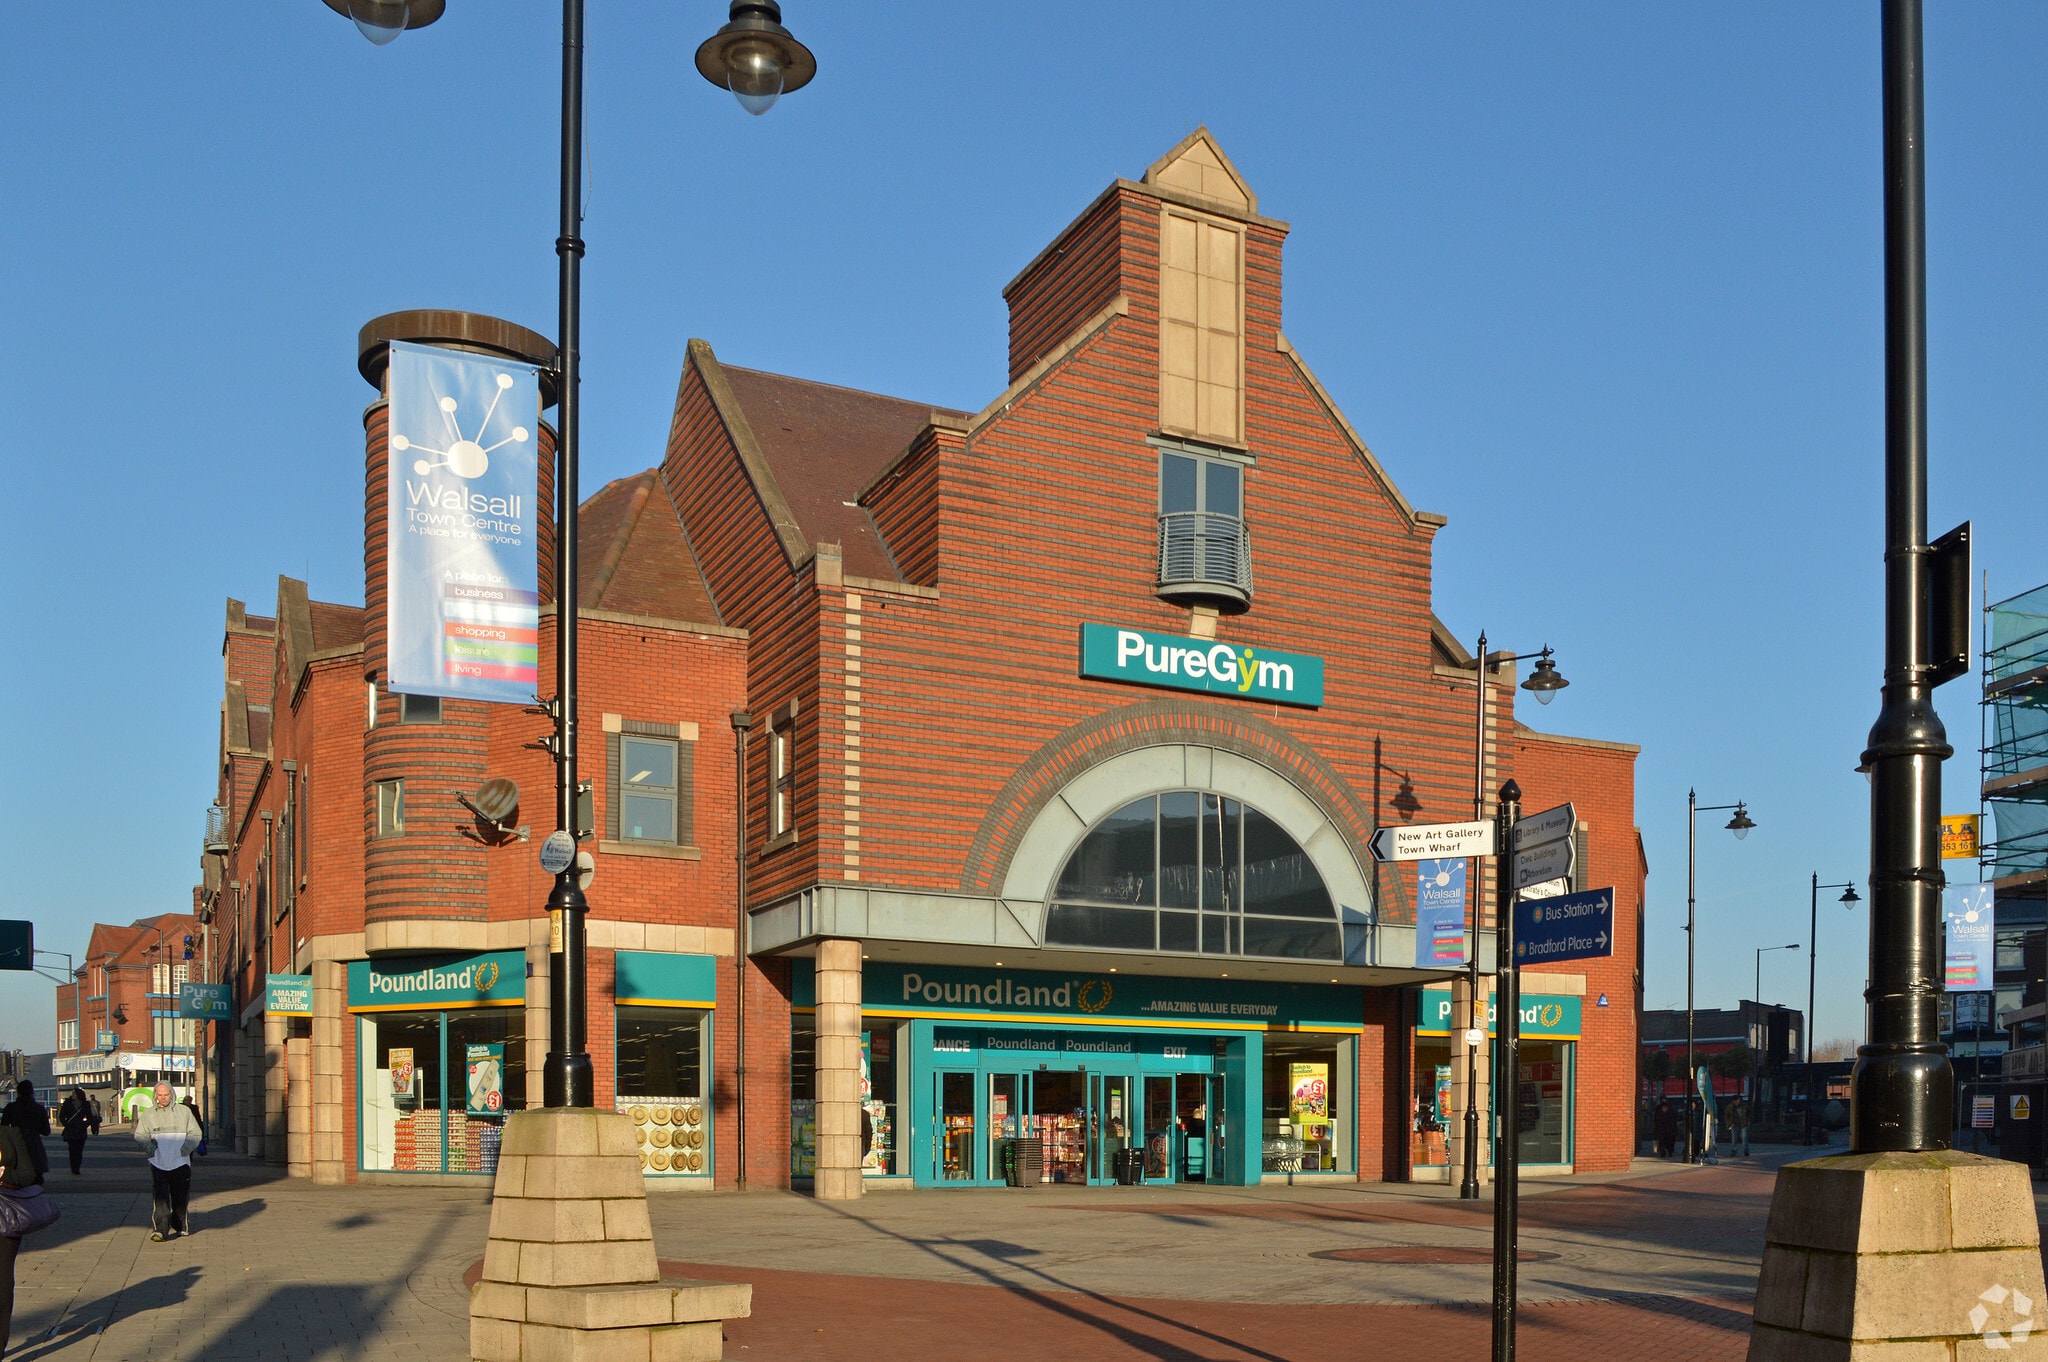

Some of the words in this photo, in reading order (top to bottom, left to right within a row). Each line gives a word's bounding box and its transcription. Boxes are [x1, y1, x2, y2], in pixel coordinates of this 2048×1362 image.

[406, 480, 521, 519] Walsall
[406, 507, 456, 526] Town
[461, 514, 522, 534] Centre
[408, 524, 417, 533] A
[420, 525, 450, 537] place
[452, 528, 469, 538] for
[471, 531, 522, 546] everyone
[455, 587, 504, 600] business
[455, 626, 506, 640] shopping
[455, 645, 490, 656] leisure
[1117, 630, 1294, 692] PureGym
[455, 664, 482, 677] living
[1523, 825, 1540, 838] Library
[1546, 817, 1567, 830] Museum
[1398, 832, 1421, 842] New
[1425, 830, 1442, 840] Art
[1445, 828, 1484, 839] Gallery
[1398, 846, 1425, 855] Town
[1428, 843, 1461, 853] Wharf
[1521, 854, 1532, 865] Civic
[1534, 847, 1557, 860] Buildings
[1527, 866, 1552, 878] Arboretum
[1422, 888, 1461, 900] Walsall
[1546, 906, 1562, 921] Bus
[1563, 902, 1594, 919] Station
[1952, 924, 1989, 934] Walsall
[1529, 937, 1566, 955] Bradford
[1568, 935, 1593, 951] Place
[369, 966, 471, 994] Poundland
[183, 985, 219, 999] Pure
[272, 989, 307, 998] AMAZING
[902, 973, 1071, 1007] Poundland
[191, 997, 227, 1012] Gym
[278, 996, 302, 1004] VALUE
[1198, 1002, 1229, 1014] VALUE
[1230, 1003, 1278, 1016] EVERYDAY
[987, 1036, 1056, 1051] Poundland
[1066, 1039, 1132, 1053] Poundland
[1163, 1046, 1188, 1059] EXIT
[1312, 1082, 1326, 1093] £1
[488, 1094, 500, 1107] £1
